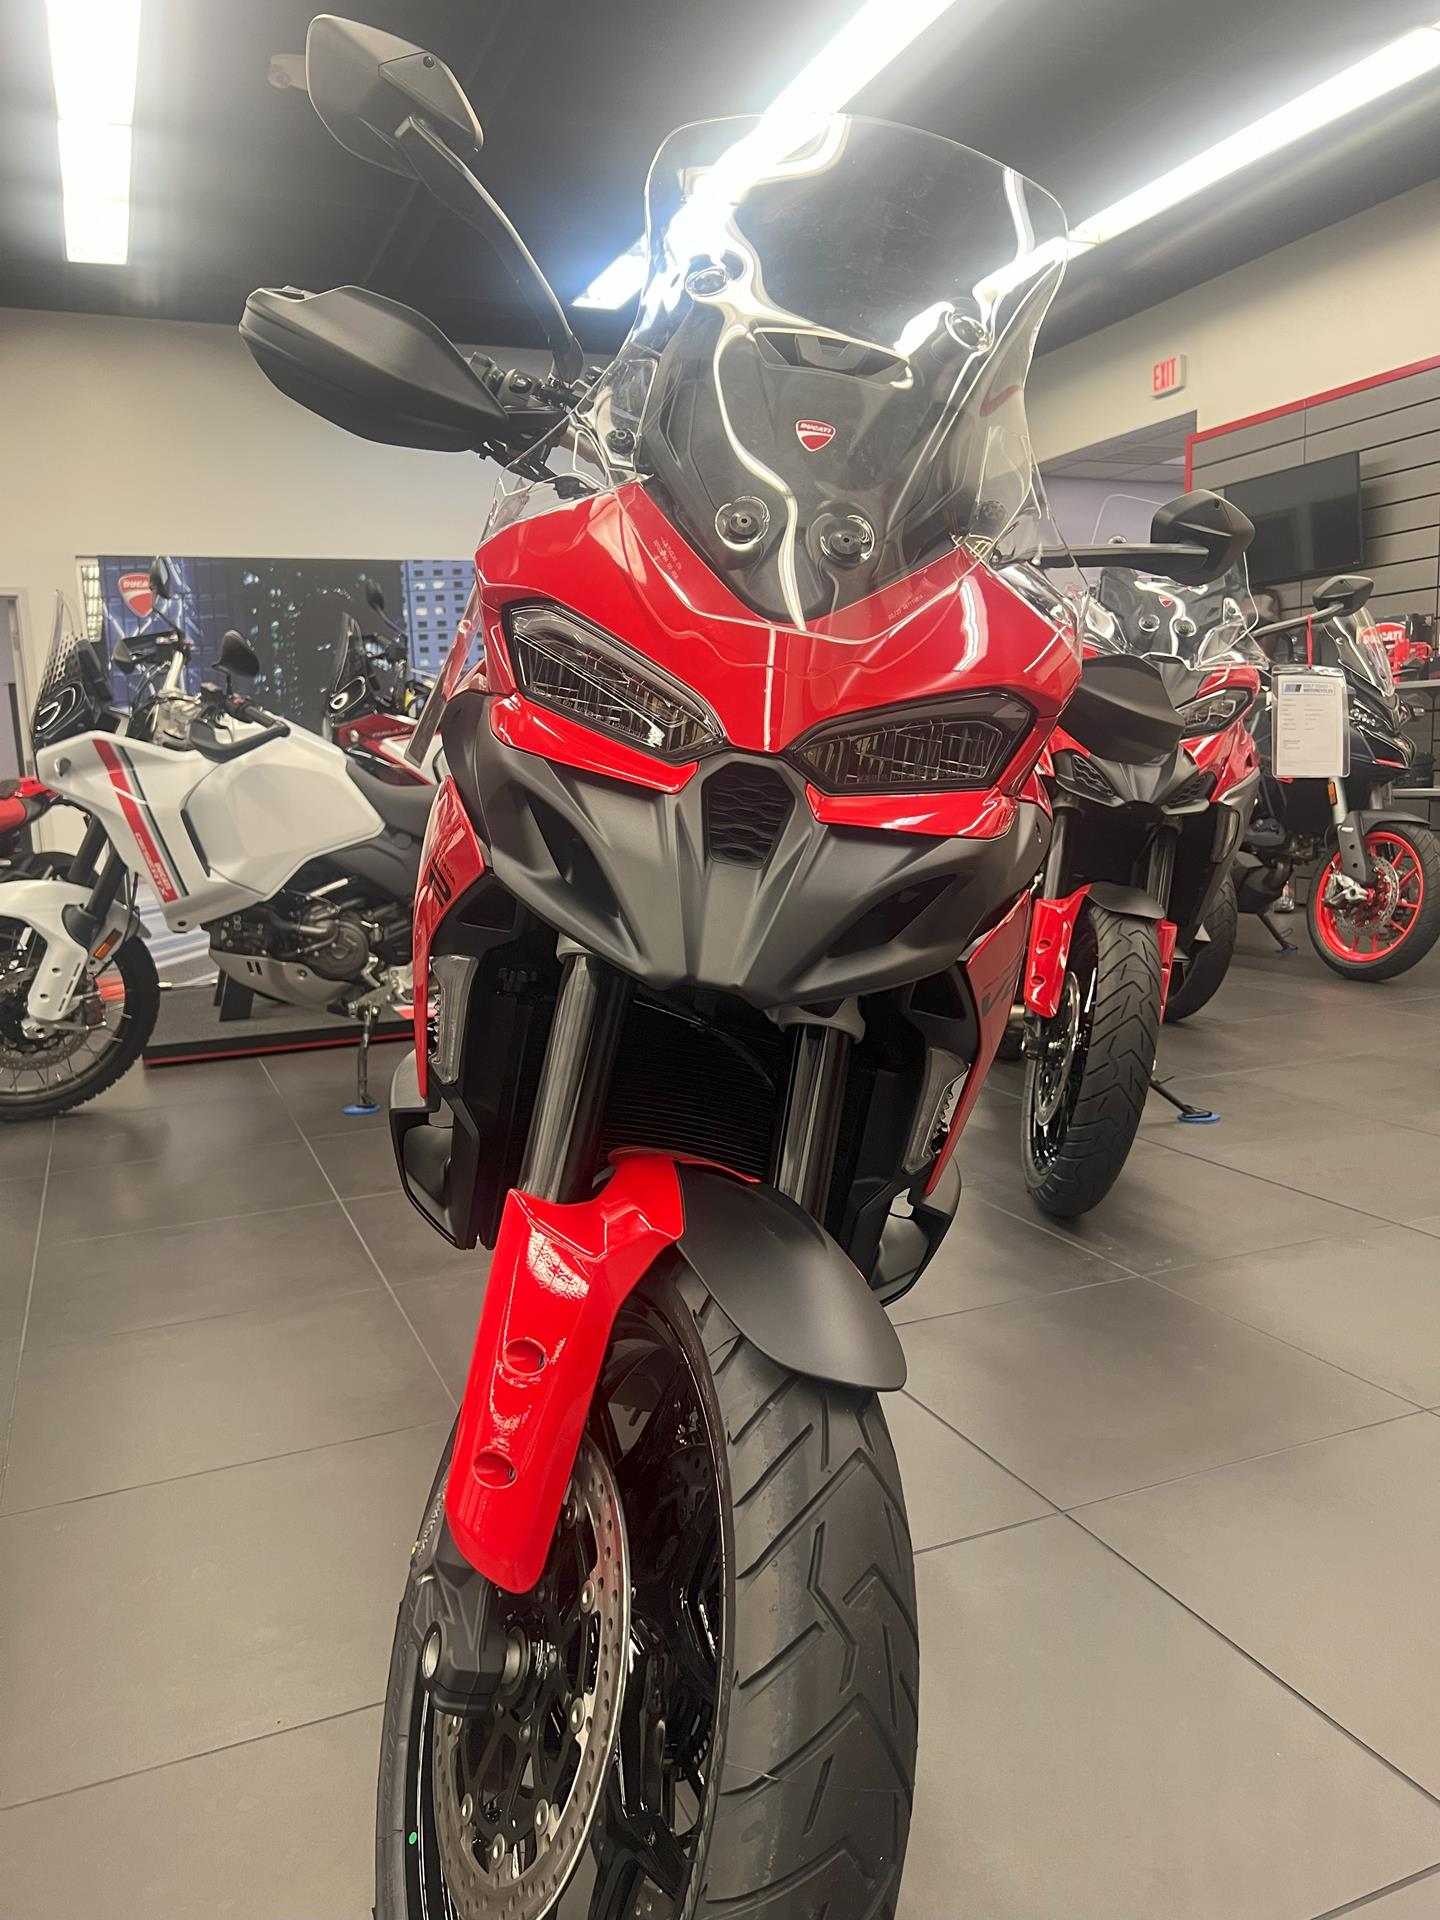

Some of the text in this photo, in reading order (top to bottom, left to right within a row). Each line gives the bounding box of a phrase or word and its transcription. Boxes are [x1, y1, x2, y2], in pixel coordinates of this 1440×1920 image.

[1153, 357, 1177, 392] EXIT
[800, 423, 832, 434] DUCATI
[122, 578, 149, 590] DUCA
